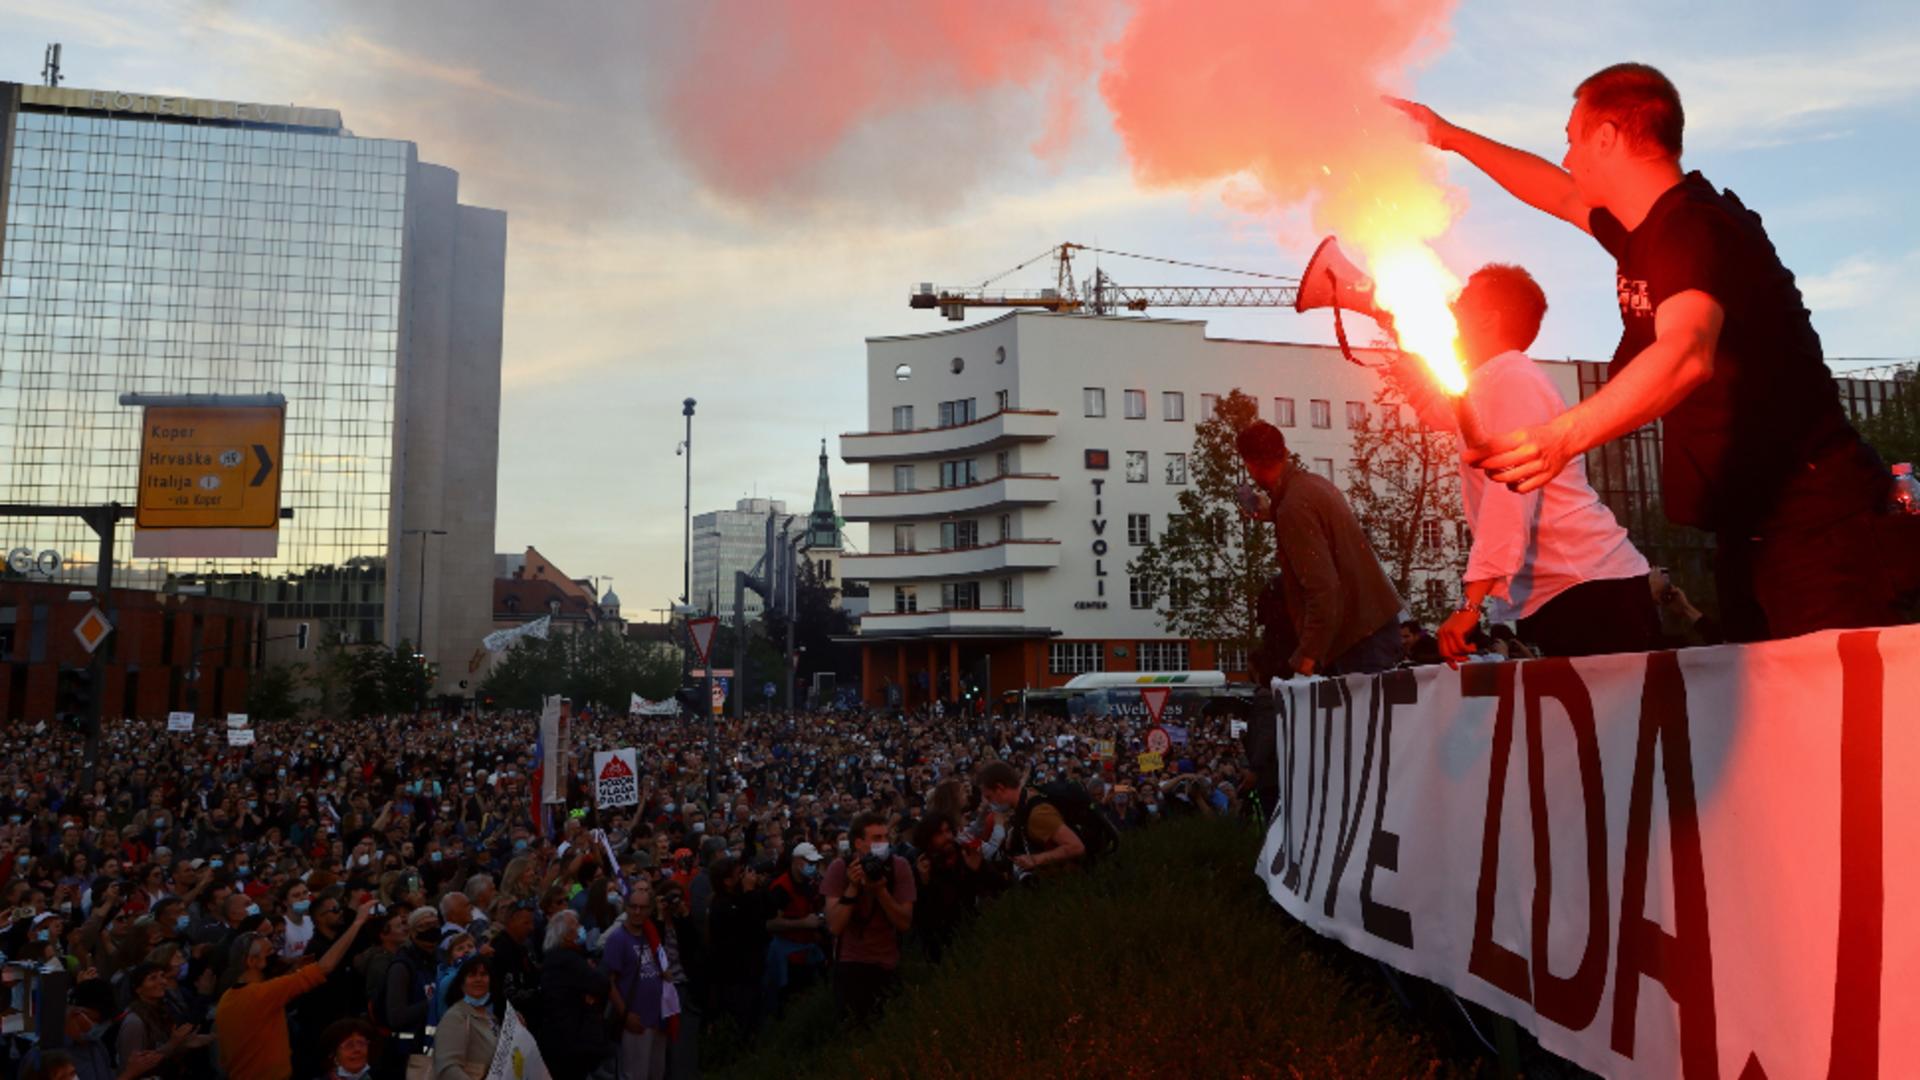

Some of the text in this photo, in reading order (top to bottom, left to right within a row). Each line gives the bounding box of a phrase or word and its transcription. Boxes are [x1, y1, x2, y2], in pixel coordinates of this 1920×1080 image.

[90, 91, 271, 120] HOTEL LEV
[151, 425, 195, 441] Koper
[150, 451, 212, 465] Hrvaška
[147, 474, 193, 491] Italija
[193, 494, 223, 507] Koper
[1091, 478, 1108, 597] TIVOLI
[1073, 600, 1108, 610] CENTER
[600, 785, 634, 796] VLADA
[1461, 631, 1885, 1080] ZDAJ
